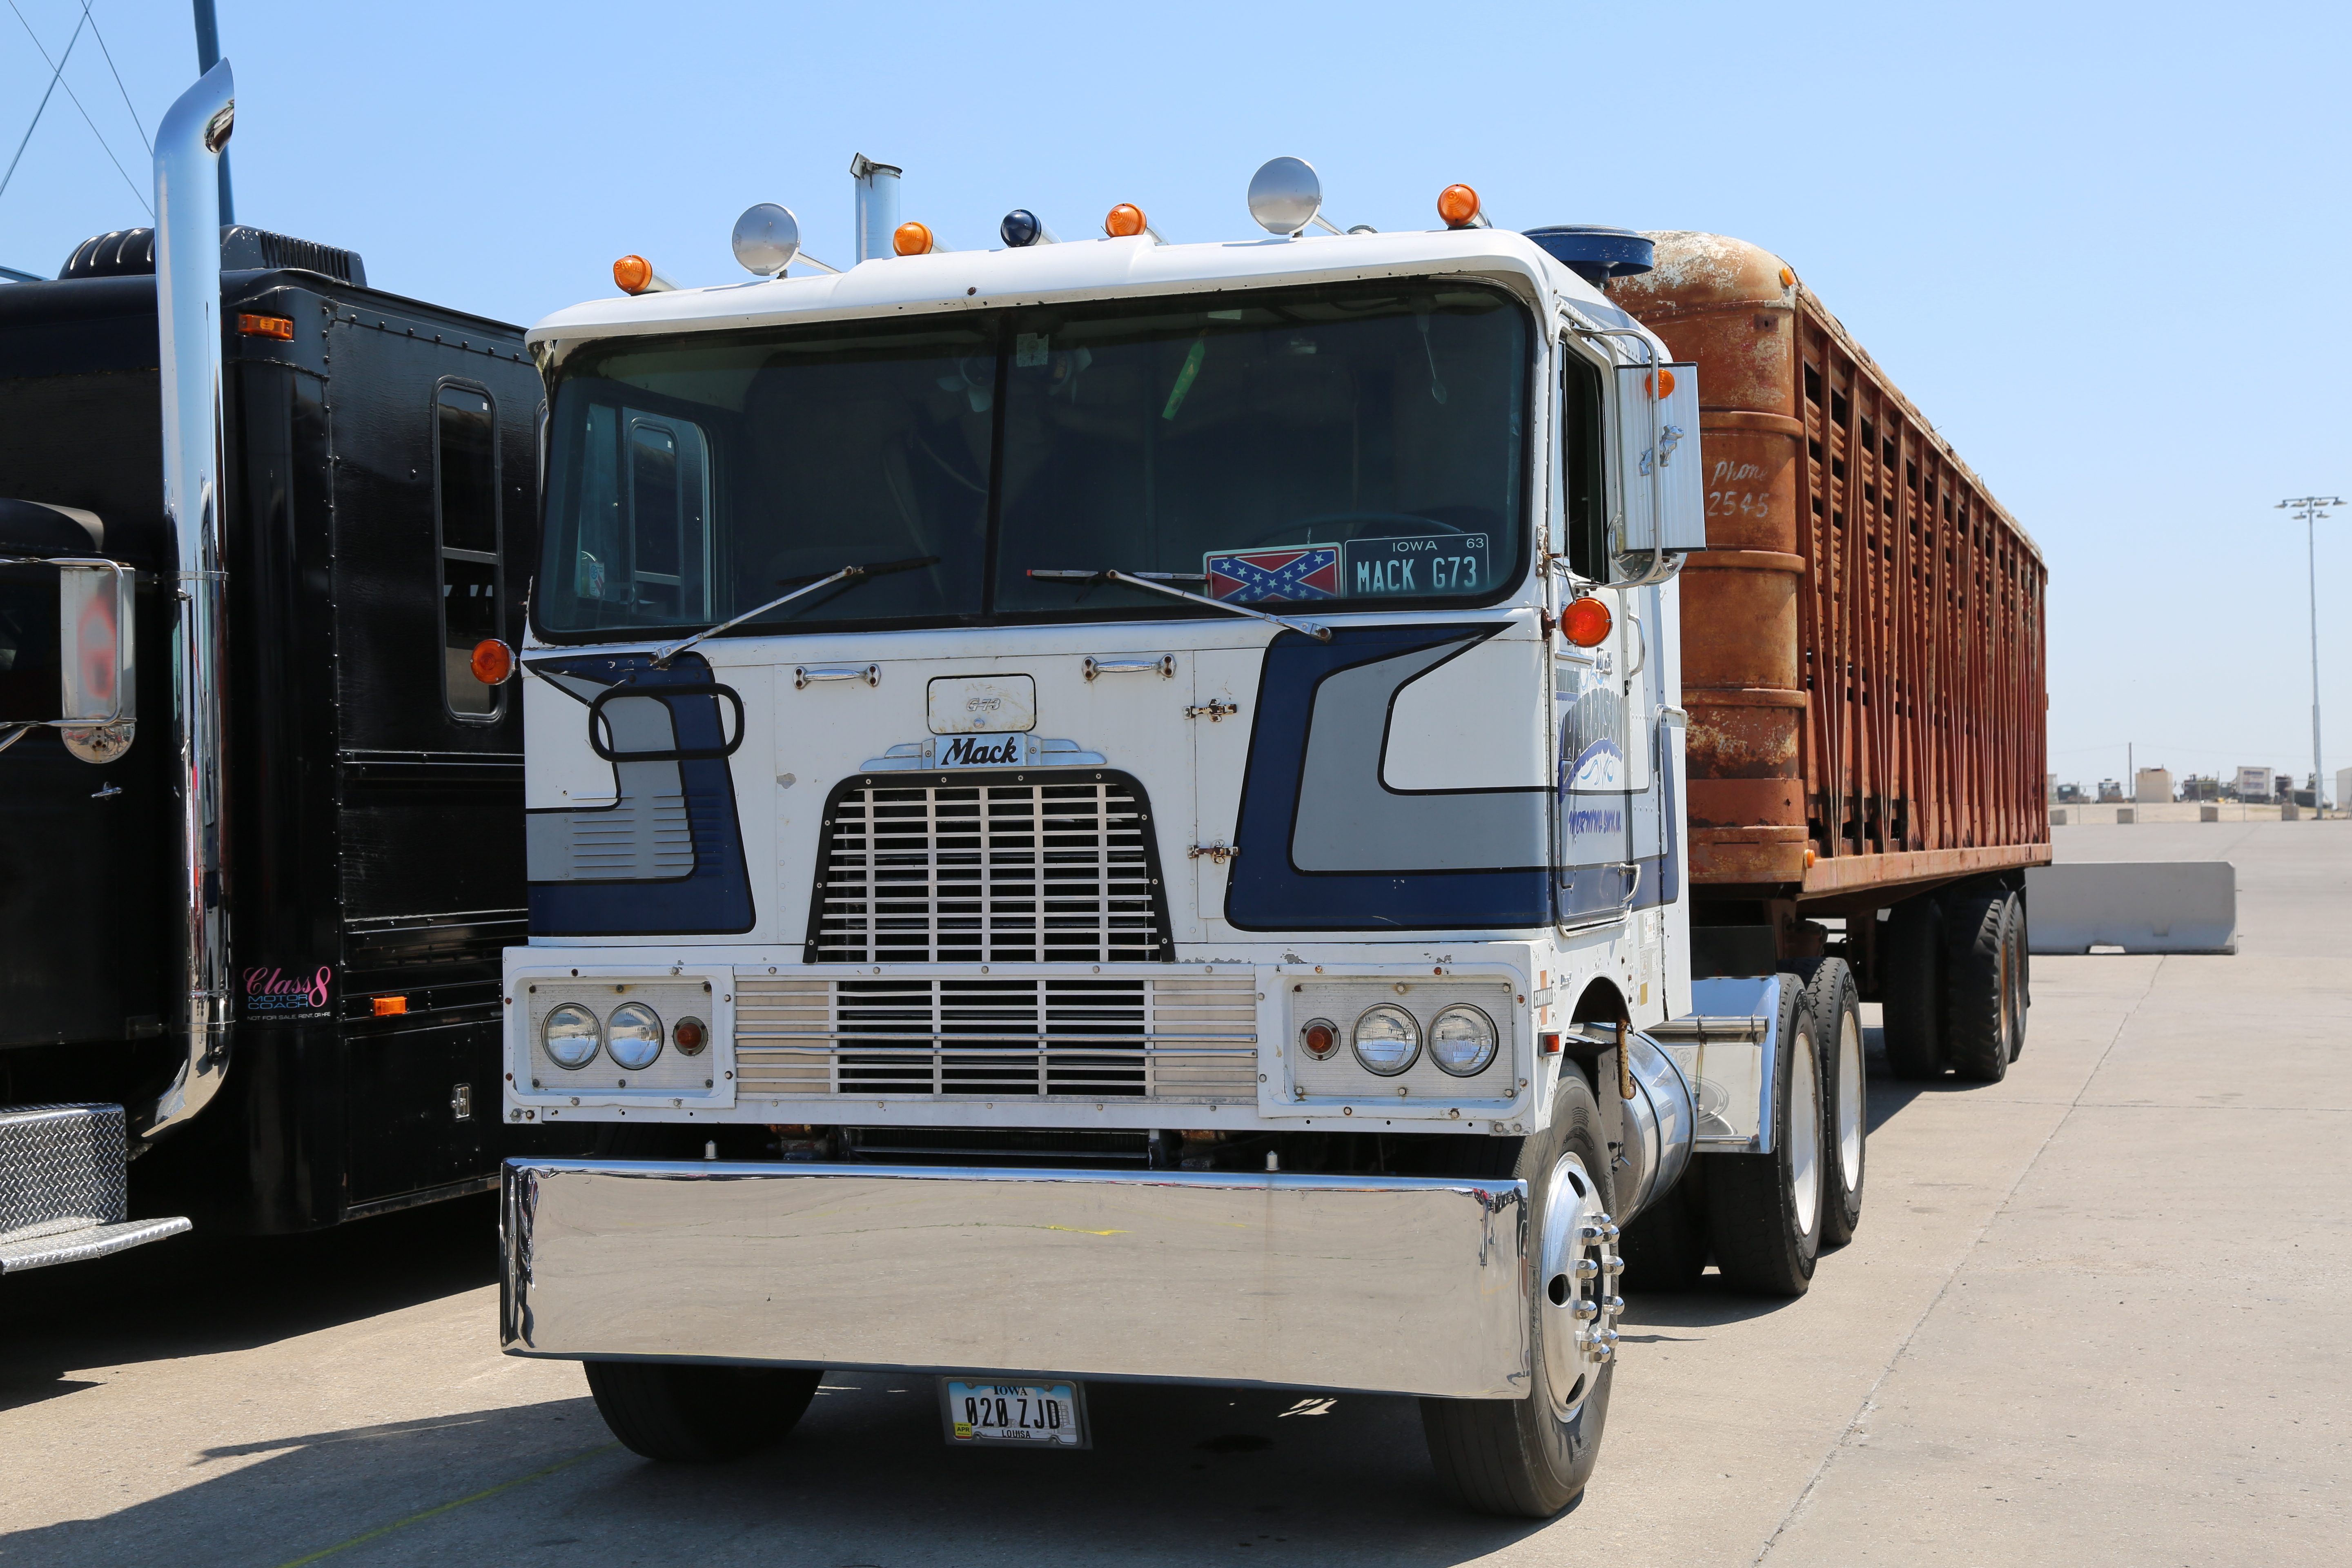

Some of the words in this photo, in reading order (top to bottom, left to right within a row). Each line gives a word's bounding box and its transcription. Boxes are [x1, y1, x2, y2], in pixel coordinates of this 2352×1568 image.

[1706, 491, 1769, 517] 2545
[1393, 541, 1437, 552] IOWA
[1466, 538, 1484, 548] 63
[1357, 559, 1415, 592] MACK
[1432, 556, 1477, 589] G73
[1563, 687, 1623, 783] HARBISON
[940, 736, 1018, 765] Mack
[243, 967, 311, 995] Class
[308, 966, 331, 1007] 8
[1535, 988, 1552, 1007] CUMMINS
[993, 1385, 1028, 1396] IOWA
[965, 1397, 1009, 1428] 020
[1017, 1399, 1060, 1429] ZJD
[1002, 1430, 1031, 1439] LOUISA
